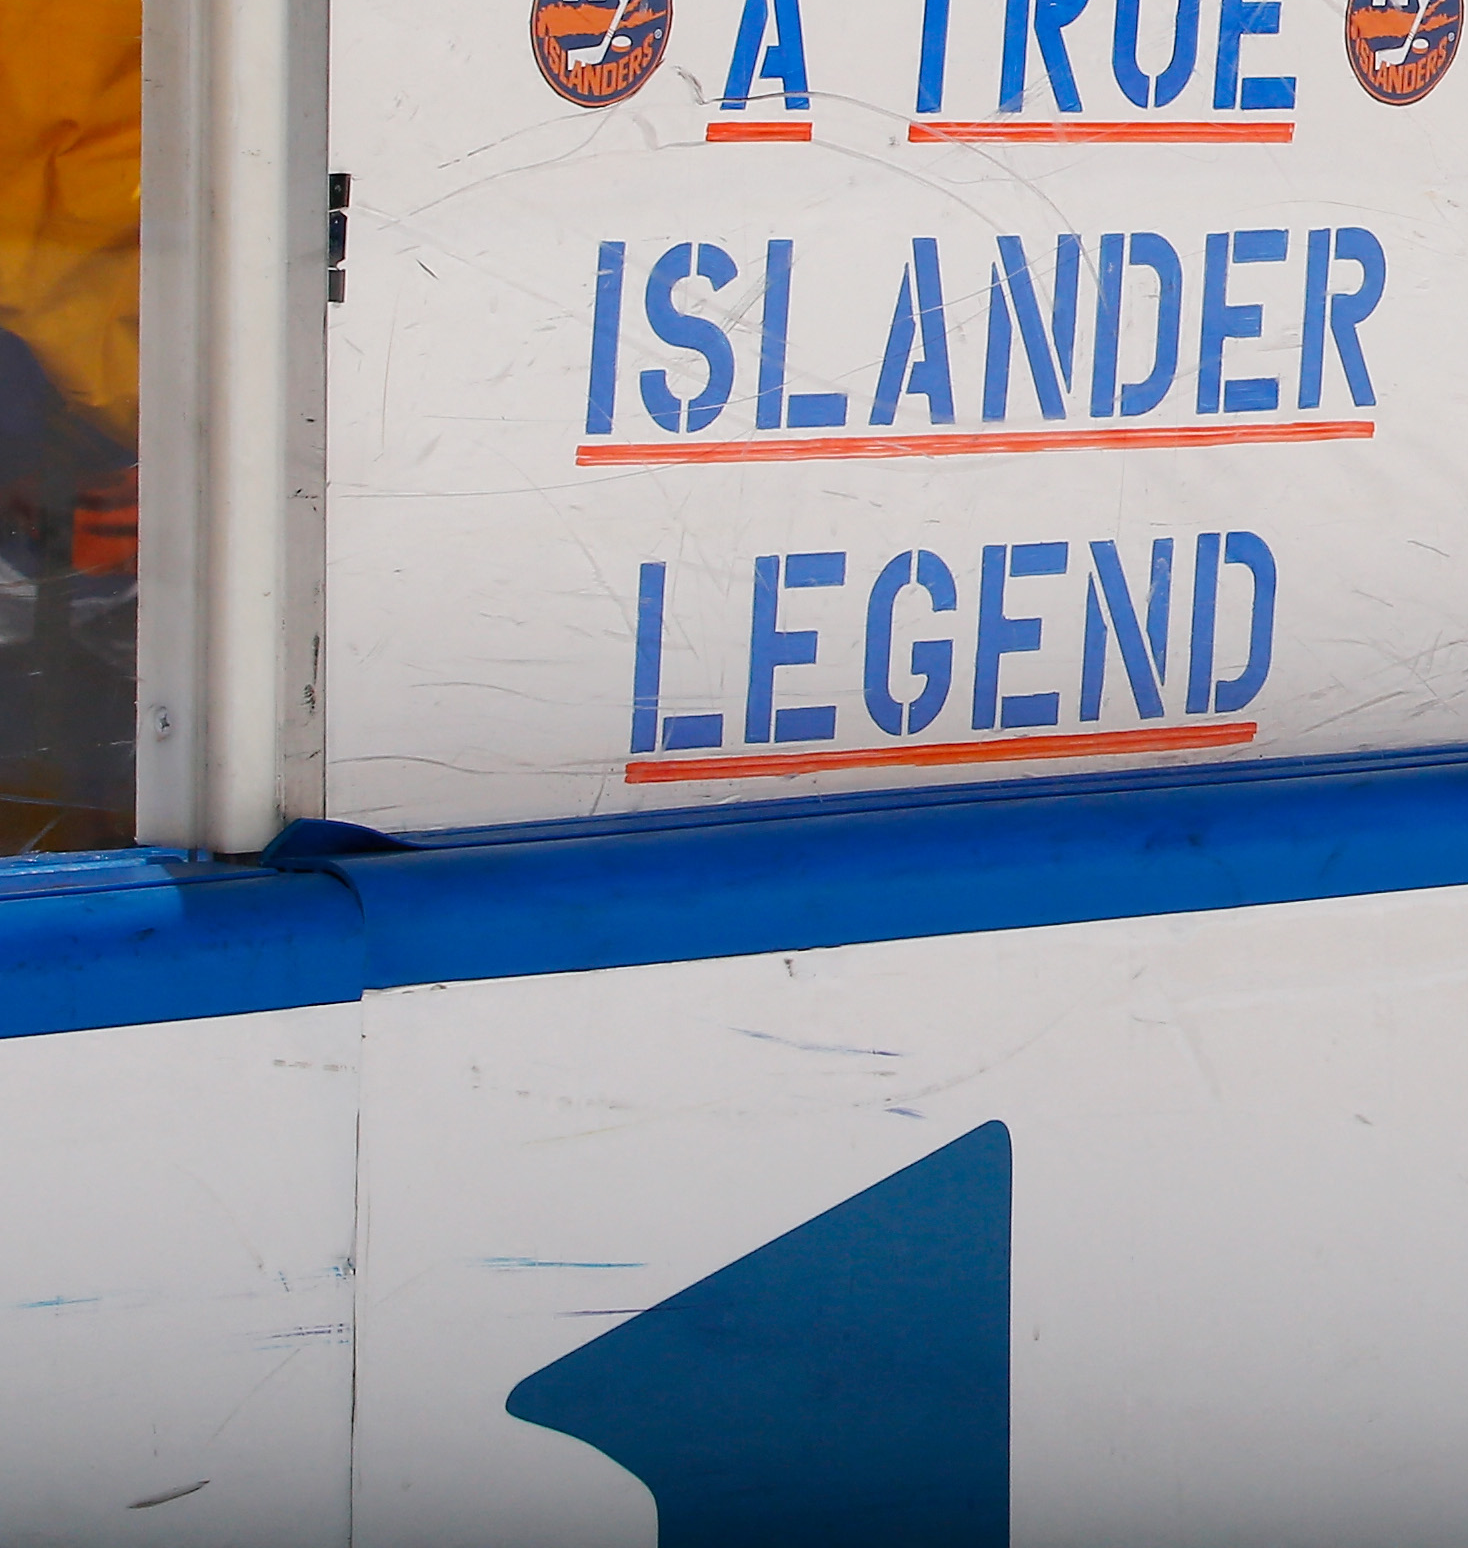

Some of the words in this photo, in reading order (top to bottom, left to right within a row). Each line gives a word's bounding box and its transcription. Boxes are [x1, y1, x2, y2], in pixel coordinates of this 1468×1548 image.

[543, 33, 655, 97] ISLANDERS
[1355, 35, 1449, 95] ISLANDERS
[585, 225, 1388, 436] ISLANDER
[630, 531, 1278, 754] LEGEND
